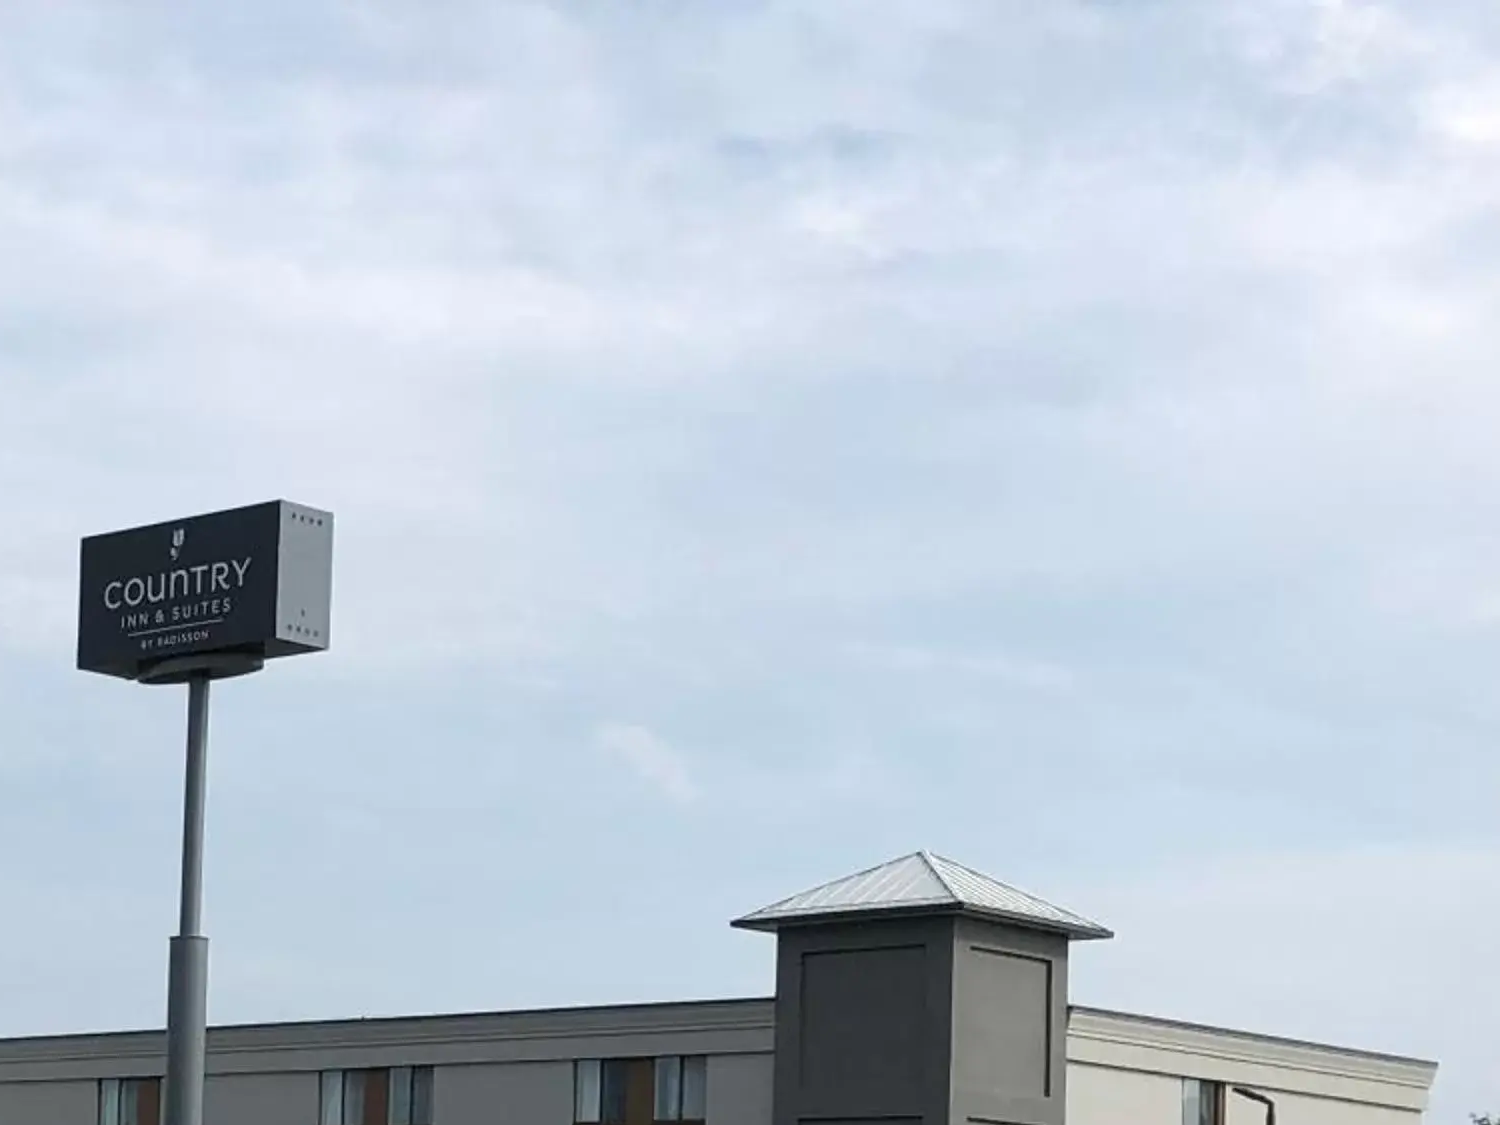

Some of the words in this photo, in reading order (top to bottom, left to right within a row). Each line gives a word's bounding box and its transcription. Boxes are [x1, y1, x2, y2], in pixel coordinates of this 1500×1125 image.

[104, 556, 252, 610] COUNTRY
[120, 612, 149, 630] INN
[155, 609, 165, 623] &
[172, 597, 232, 621] SUITES
